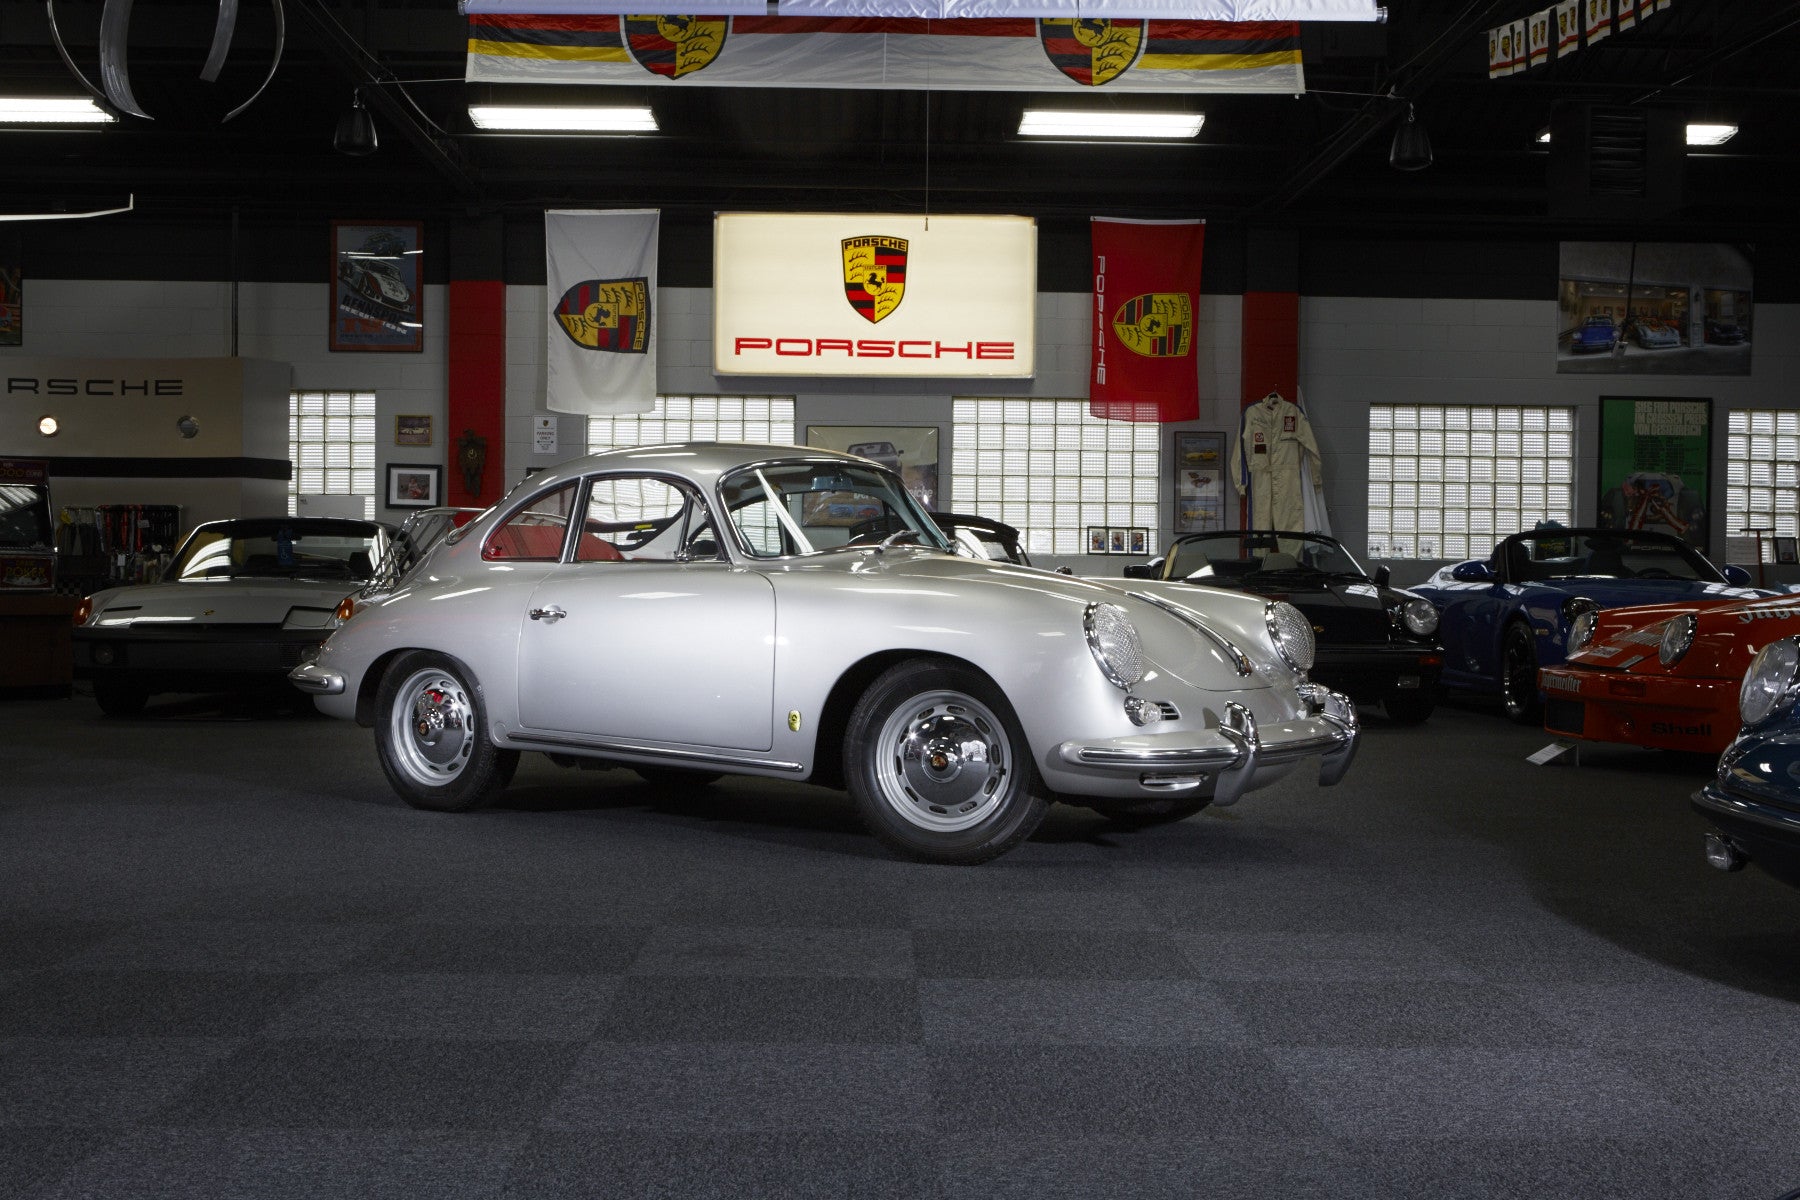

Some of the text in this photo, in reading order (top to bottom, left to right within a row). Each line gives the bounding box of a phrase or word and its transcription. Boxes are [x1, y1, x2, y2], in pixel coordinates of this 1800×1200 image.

[844, 238, 906, 251] PORSCHE
[634, 282, 645, 350] PORSCHE
[1096, 256, 1106, 385] PORSCHE
[1178, 295, 1190, 353] PORSCHE
[735, 337, 1015, 360] PORSCHE
[8, 377, 183, 395] RSCHE
[1652, 722, 1711, 737] Shell
